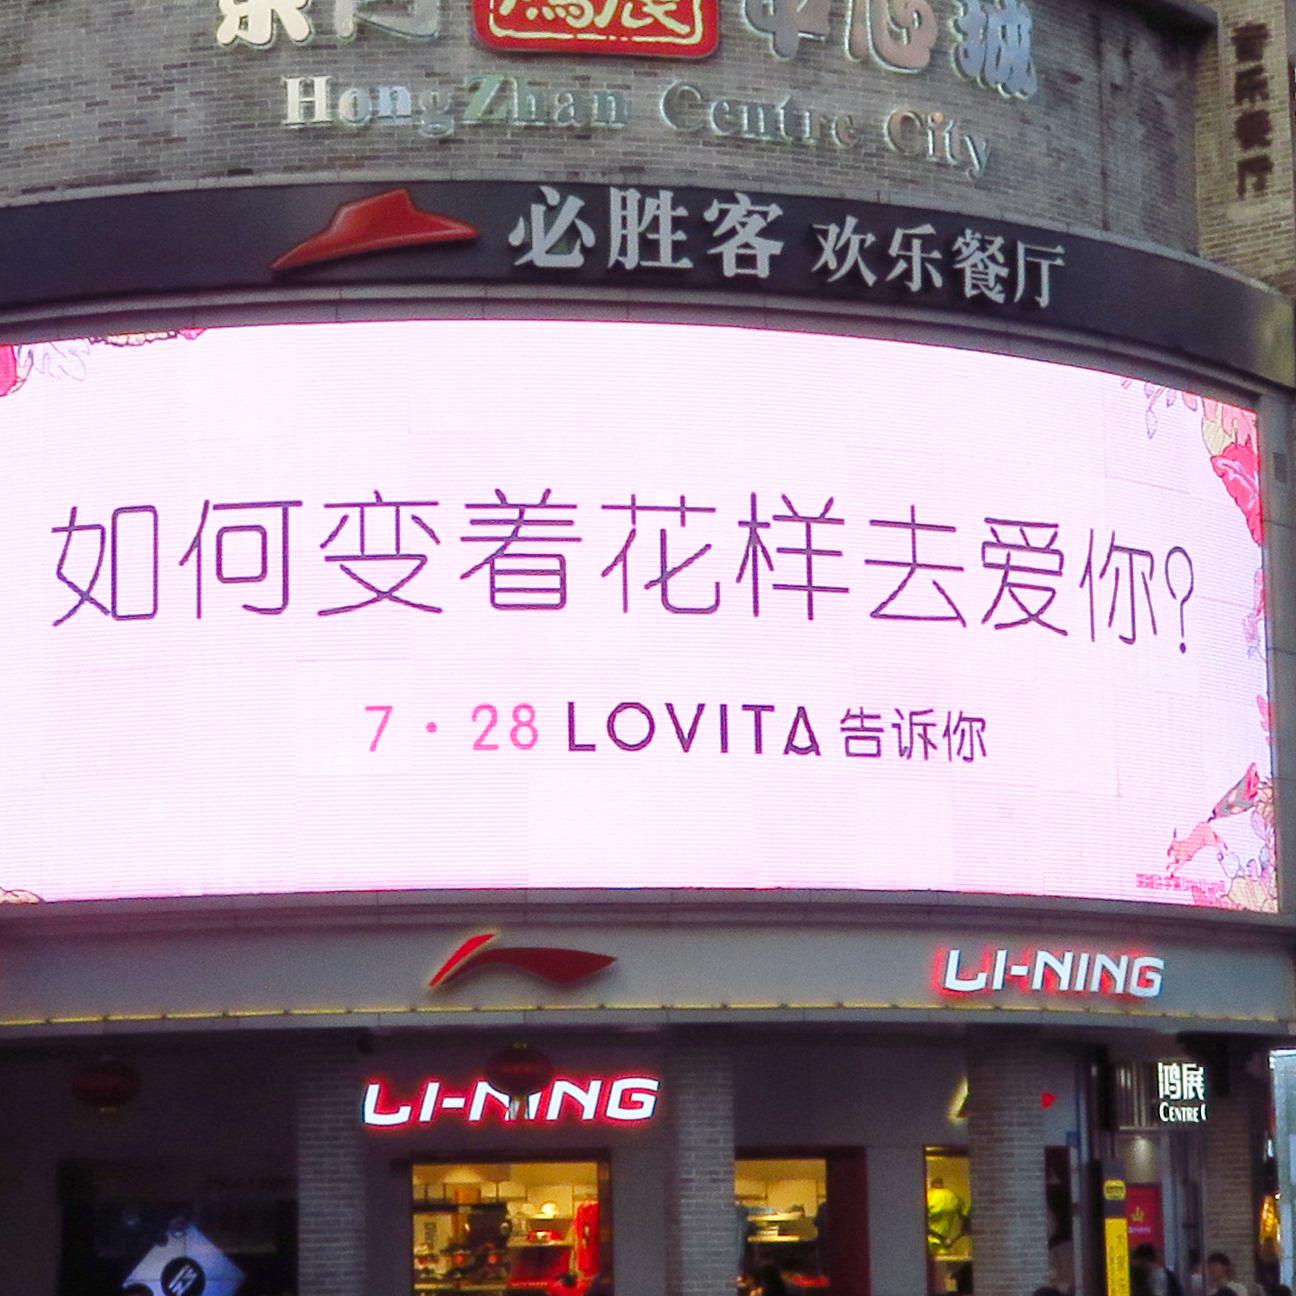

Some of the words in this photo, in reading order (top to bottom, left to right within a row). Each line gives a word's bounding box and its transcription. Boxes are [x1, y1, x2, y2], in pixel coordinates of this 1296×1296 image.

[661, 80, 860, 150] Centre
[884, 111, 992, 178] City
[508, 185, 784, 279] 必胜客
[812, 215, 1065, 309] 欢乐餐厅
[50, 488, 1197, 657] 如何变着花样去爱你?
[565, 700, 823, 756] LOVITA
[839, 708, 989, 763] 告诉你
[944, 948, 1165, 998] LI-NING
[1158, 1062, 1206, 1101] 鸿展
